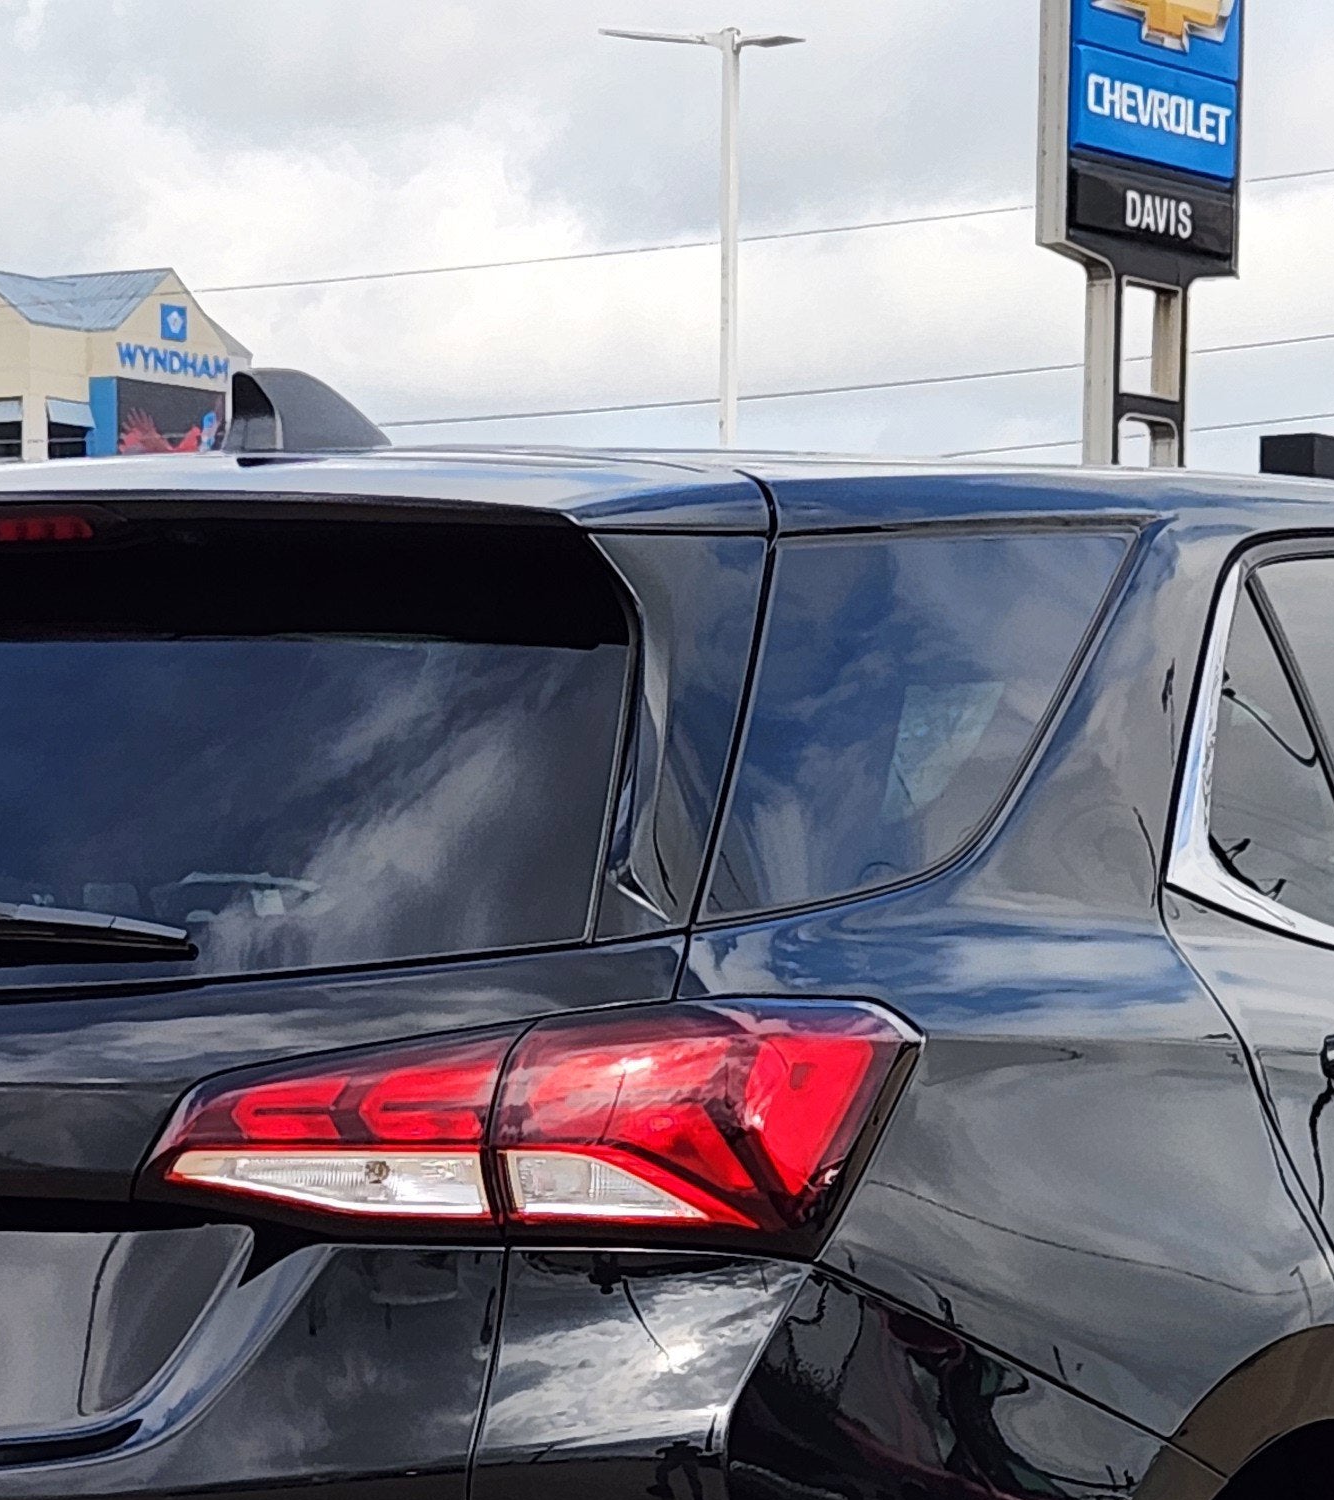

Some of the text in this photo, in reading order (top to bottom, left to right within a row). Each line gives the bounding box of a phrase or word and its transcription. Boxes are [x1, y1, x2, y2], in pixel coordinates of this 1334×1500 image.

[1087, 73, 1232, 145] CHEVROLET
[1125, 190, 1193, 239] DAVIS
[117, 342, 230, 382] WYNDHAM
